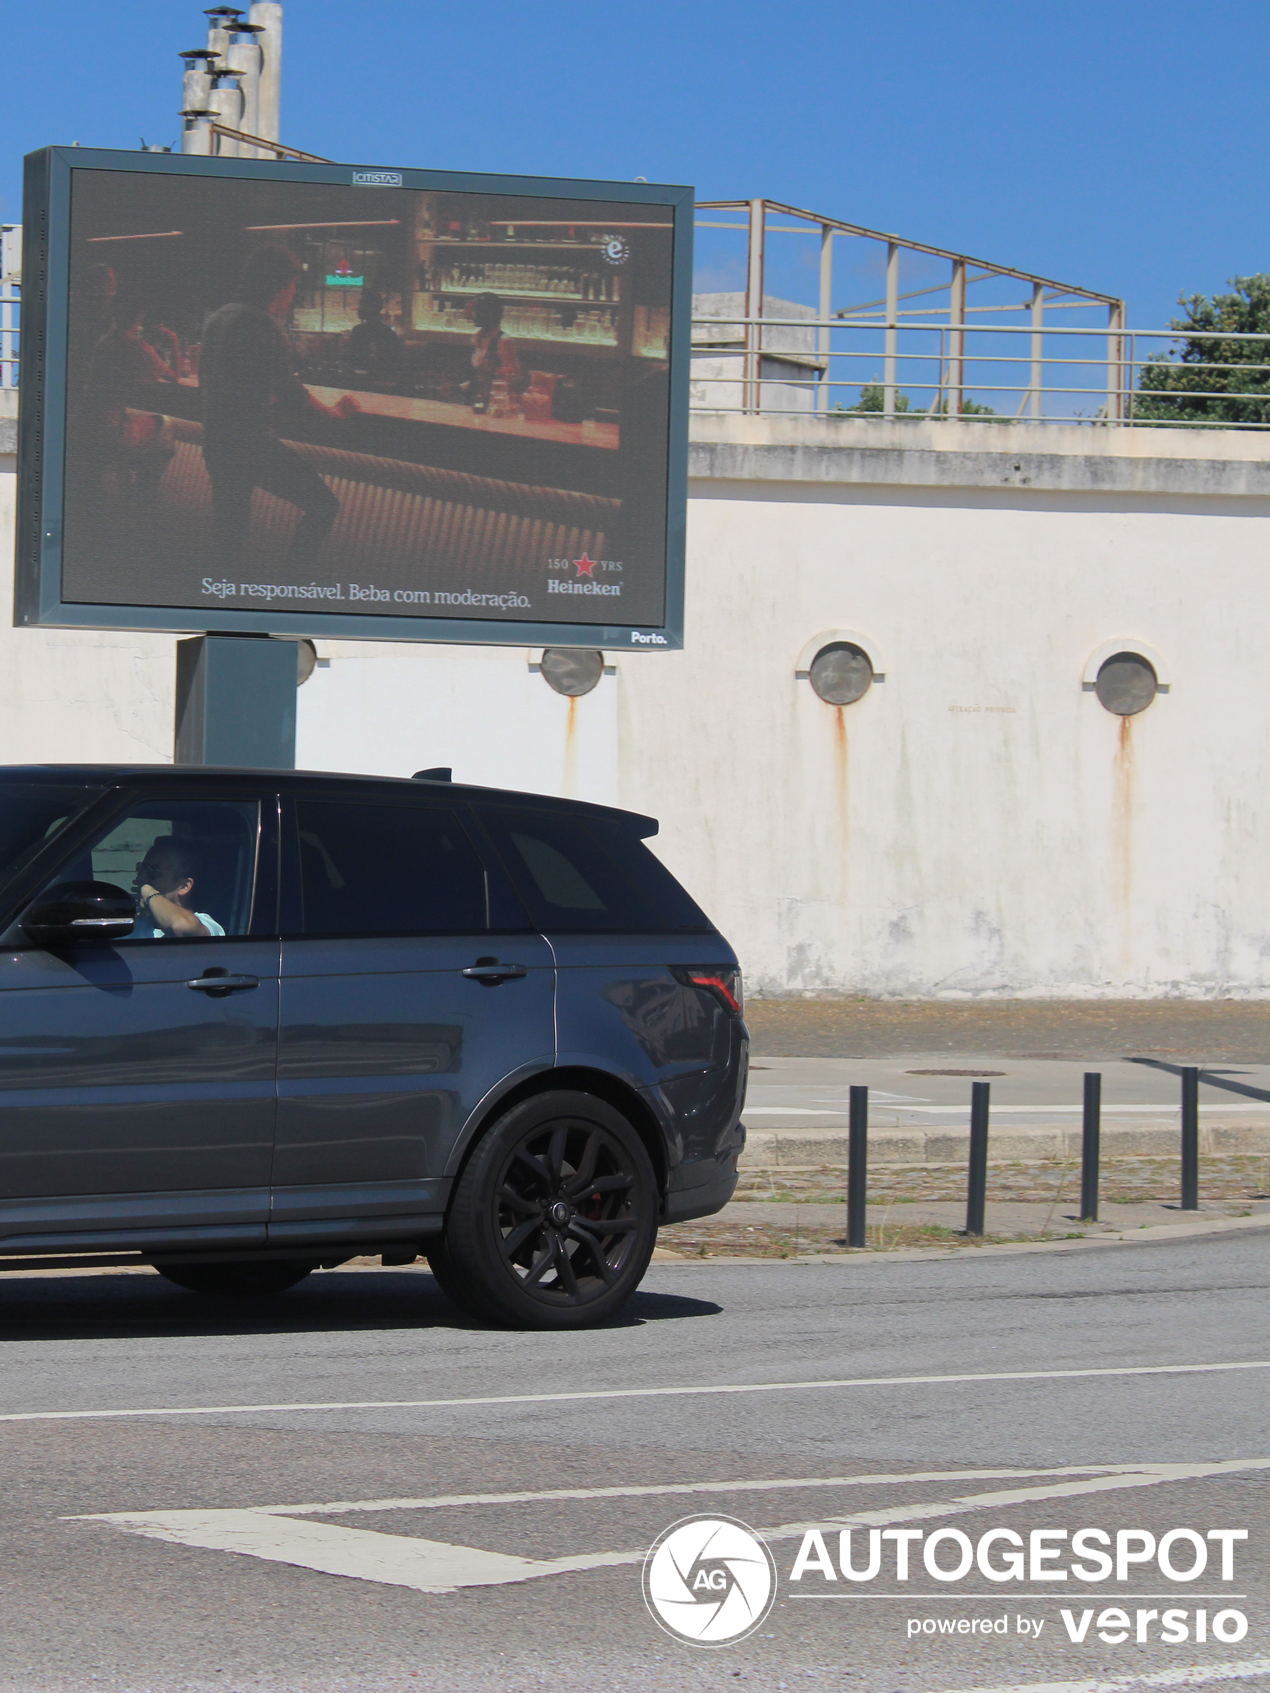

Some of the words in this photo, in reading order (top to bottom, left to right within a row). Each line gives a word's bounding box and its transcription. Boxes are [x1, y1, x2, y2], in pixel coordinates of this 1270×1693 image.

[356, 173, 399, 184] CITISTAR
[548, 559, 569, 569] 150
[600, 560, 623, 571] YRS
[201, 578, 236, 599] Seja
[239, 582, 345, 600] responsável.
[349, 583, 390, 601] Beba
[393, 590, 431, 603] com
[434, 589, 531, 610] moderação.
[547, 579, 621, 596] Heineken
[631, 631, 668, 645] Porto.
